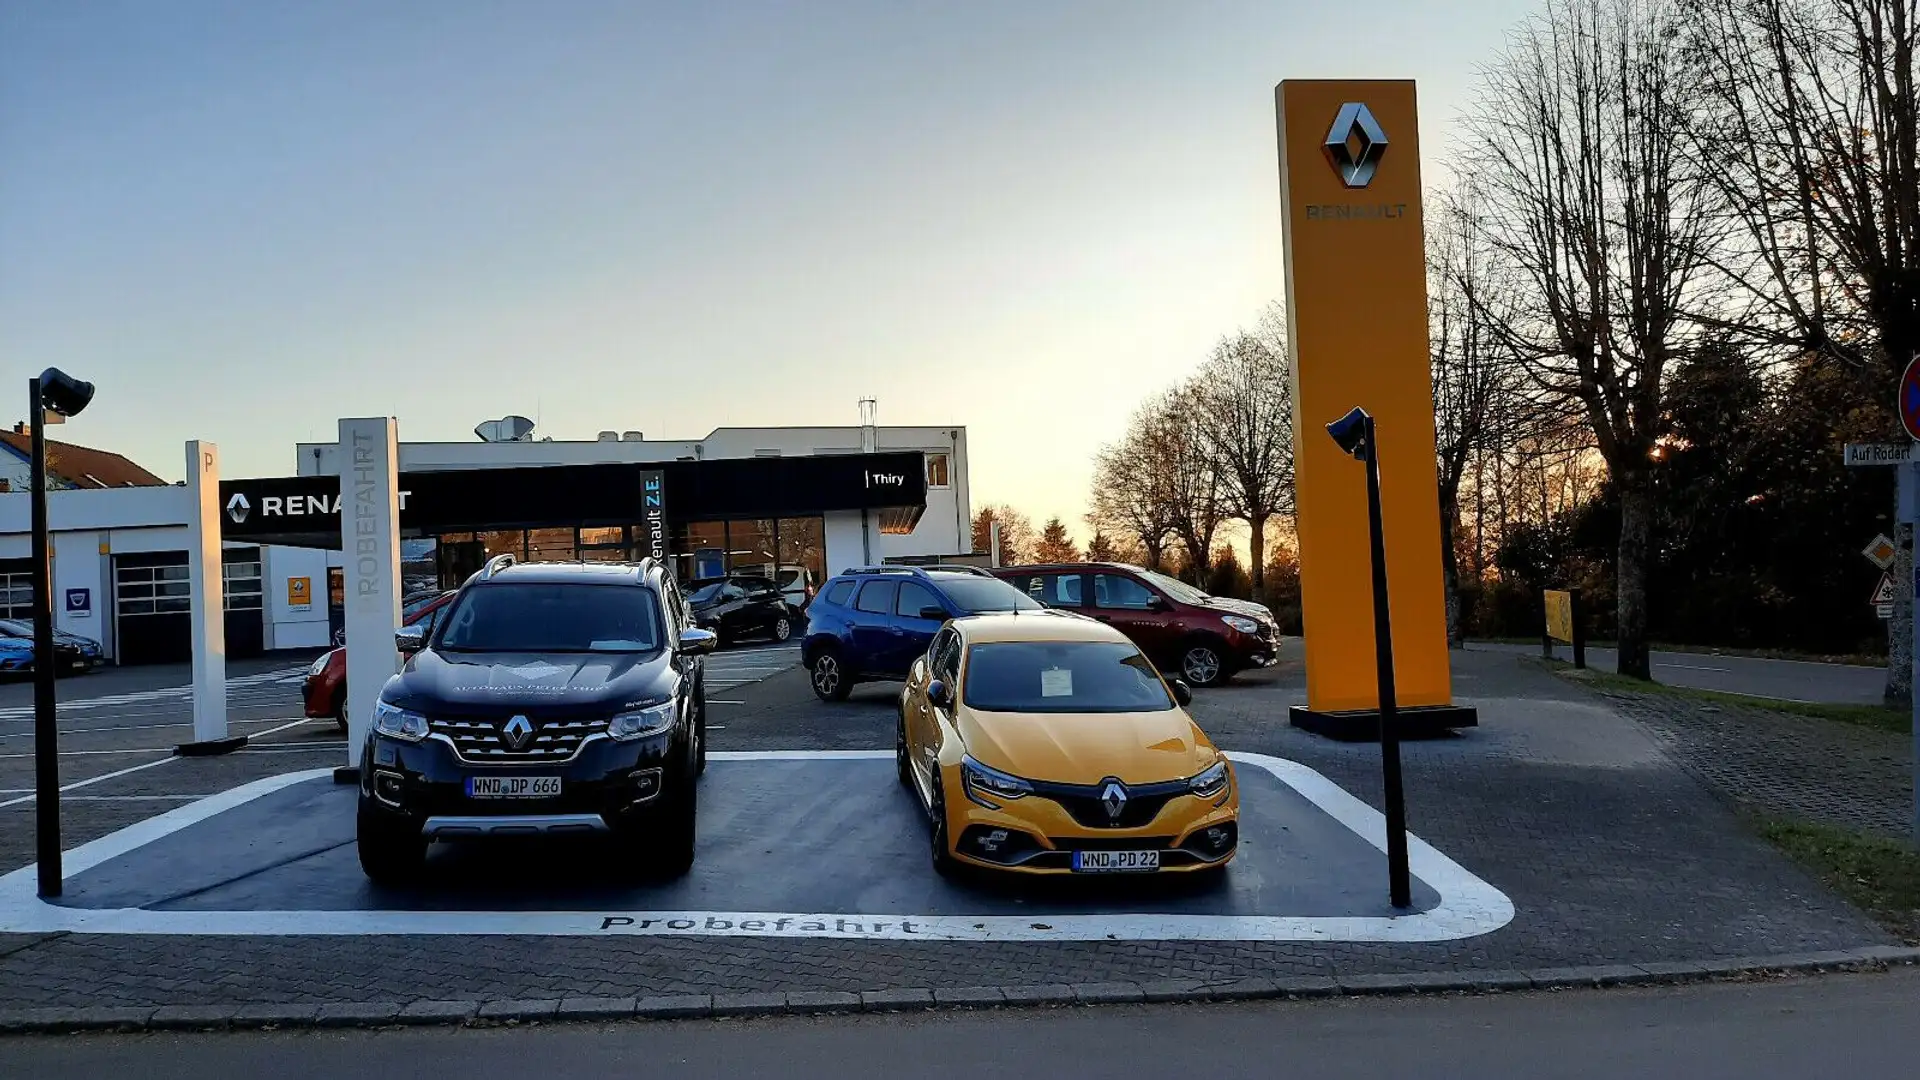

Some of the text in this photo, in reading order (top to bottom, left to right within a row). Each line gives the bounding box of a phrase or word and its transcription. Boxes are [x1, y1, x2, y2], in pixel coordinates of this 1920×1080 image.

[1306, 204, 1407, 220] RENAULT
[204, 451, 213, 473] P
[1851, 446, 1871, 461] Auf
[872, 473, 904, 486] Thiry
[645, 475, 660, 507] Z.E.
[262, 490, 412, 516] RENAT
[353, 429, 380, 614] ROBEFAHRT
[474, 778, 559, 793] WND DP 666
[1082, 852, 1157, 867] WND PD 22
[600, 916, 919, 934] Probefahrt
